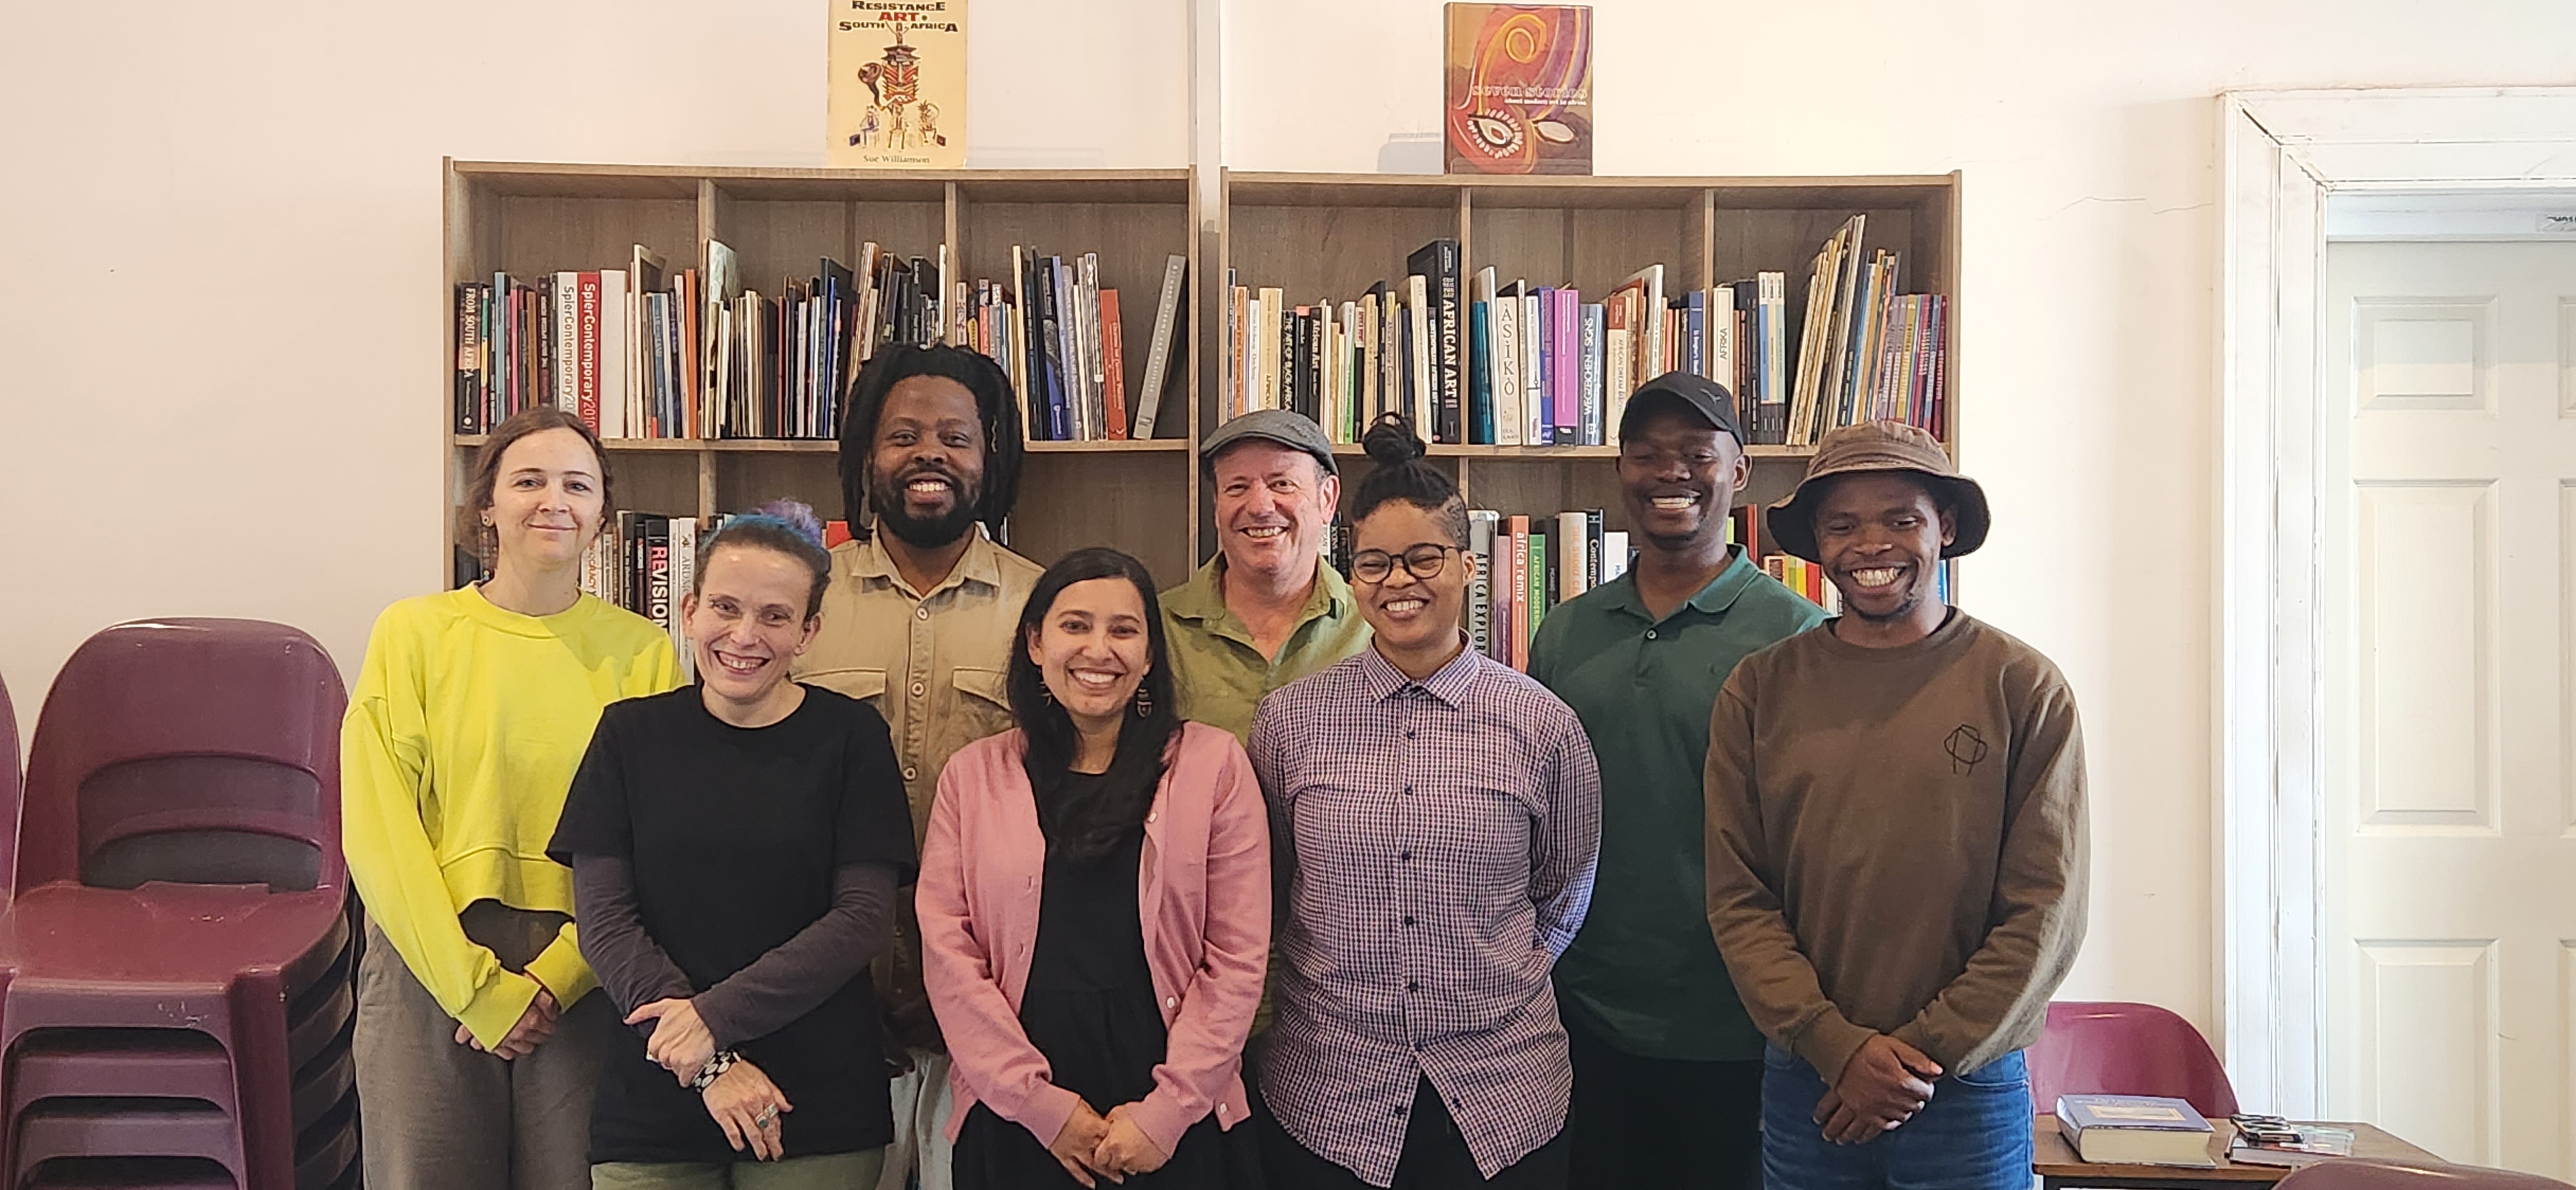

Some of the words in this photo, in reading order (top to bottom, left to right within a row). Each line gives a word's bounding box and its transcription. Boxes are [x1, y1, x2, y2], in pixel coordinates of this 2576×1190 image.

[851, 1, 945, 11] RESISTANCE
[878, 12, 920, 21] ART
[839, 21, 886, 31] SOUTH
[910, 23, 958, 32] AFRICA
[1472, 84, 1522, 97] seven
[1525, 84, 1587, 98] stories
[881, 155, 930, 164] Williamson
[465, 287, 476, 314] FROM
[464, 314, 475, 344] SOUTH
[1312, 319, 1320, 353] African
[1443, 299, 1456, 366] AFRICAN
[1584, 317, 1594, 347] SIGNS
[463, 346, 475, 378] AFRICA
[562, 286, 576, 411] SpierContemporary20
[582, 283, 596, 428] SpierContemporary2010
[1312, 354, 1320, 369] Art
[1444, 368, 1457, 398] ART
[1516, 532, 1527, 565] africa
[1475, 552, 1489, 598] AFRICA
[1516, 569, 1525, 603] remix
